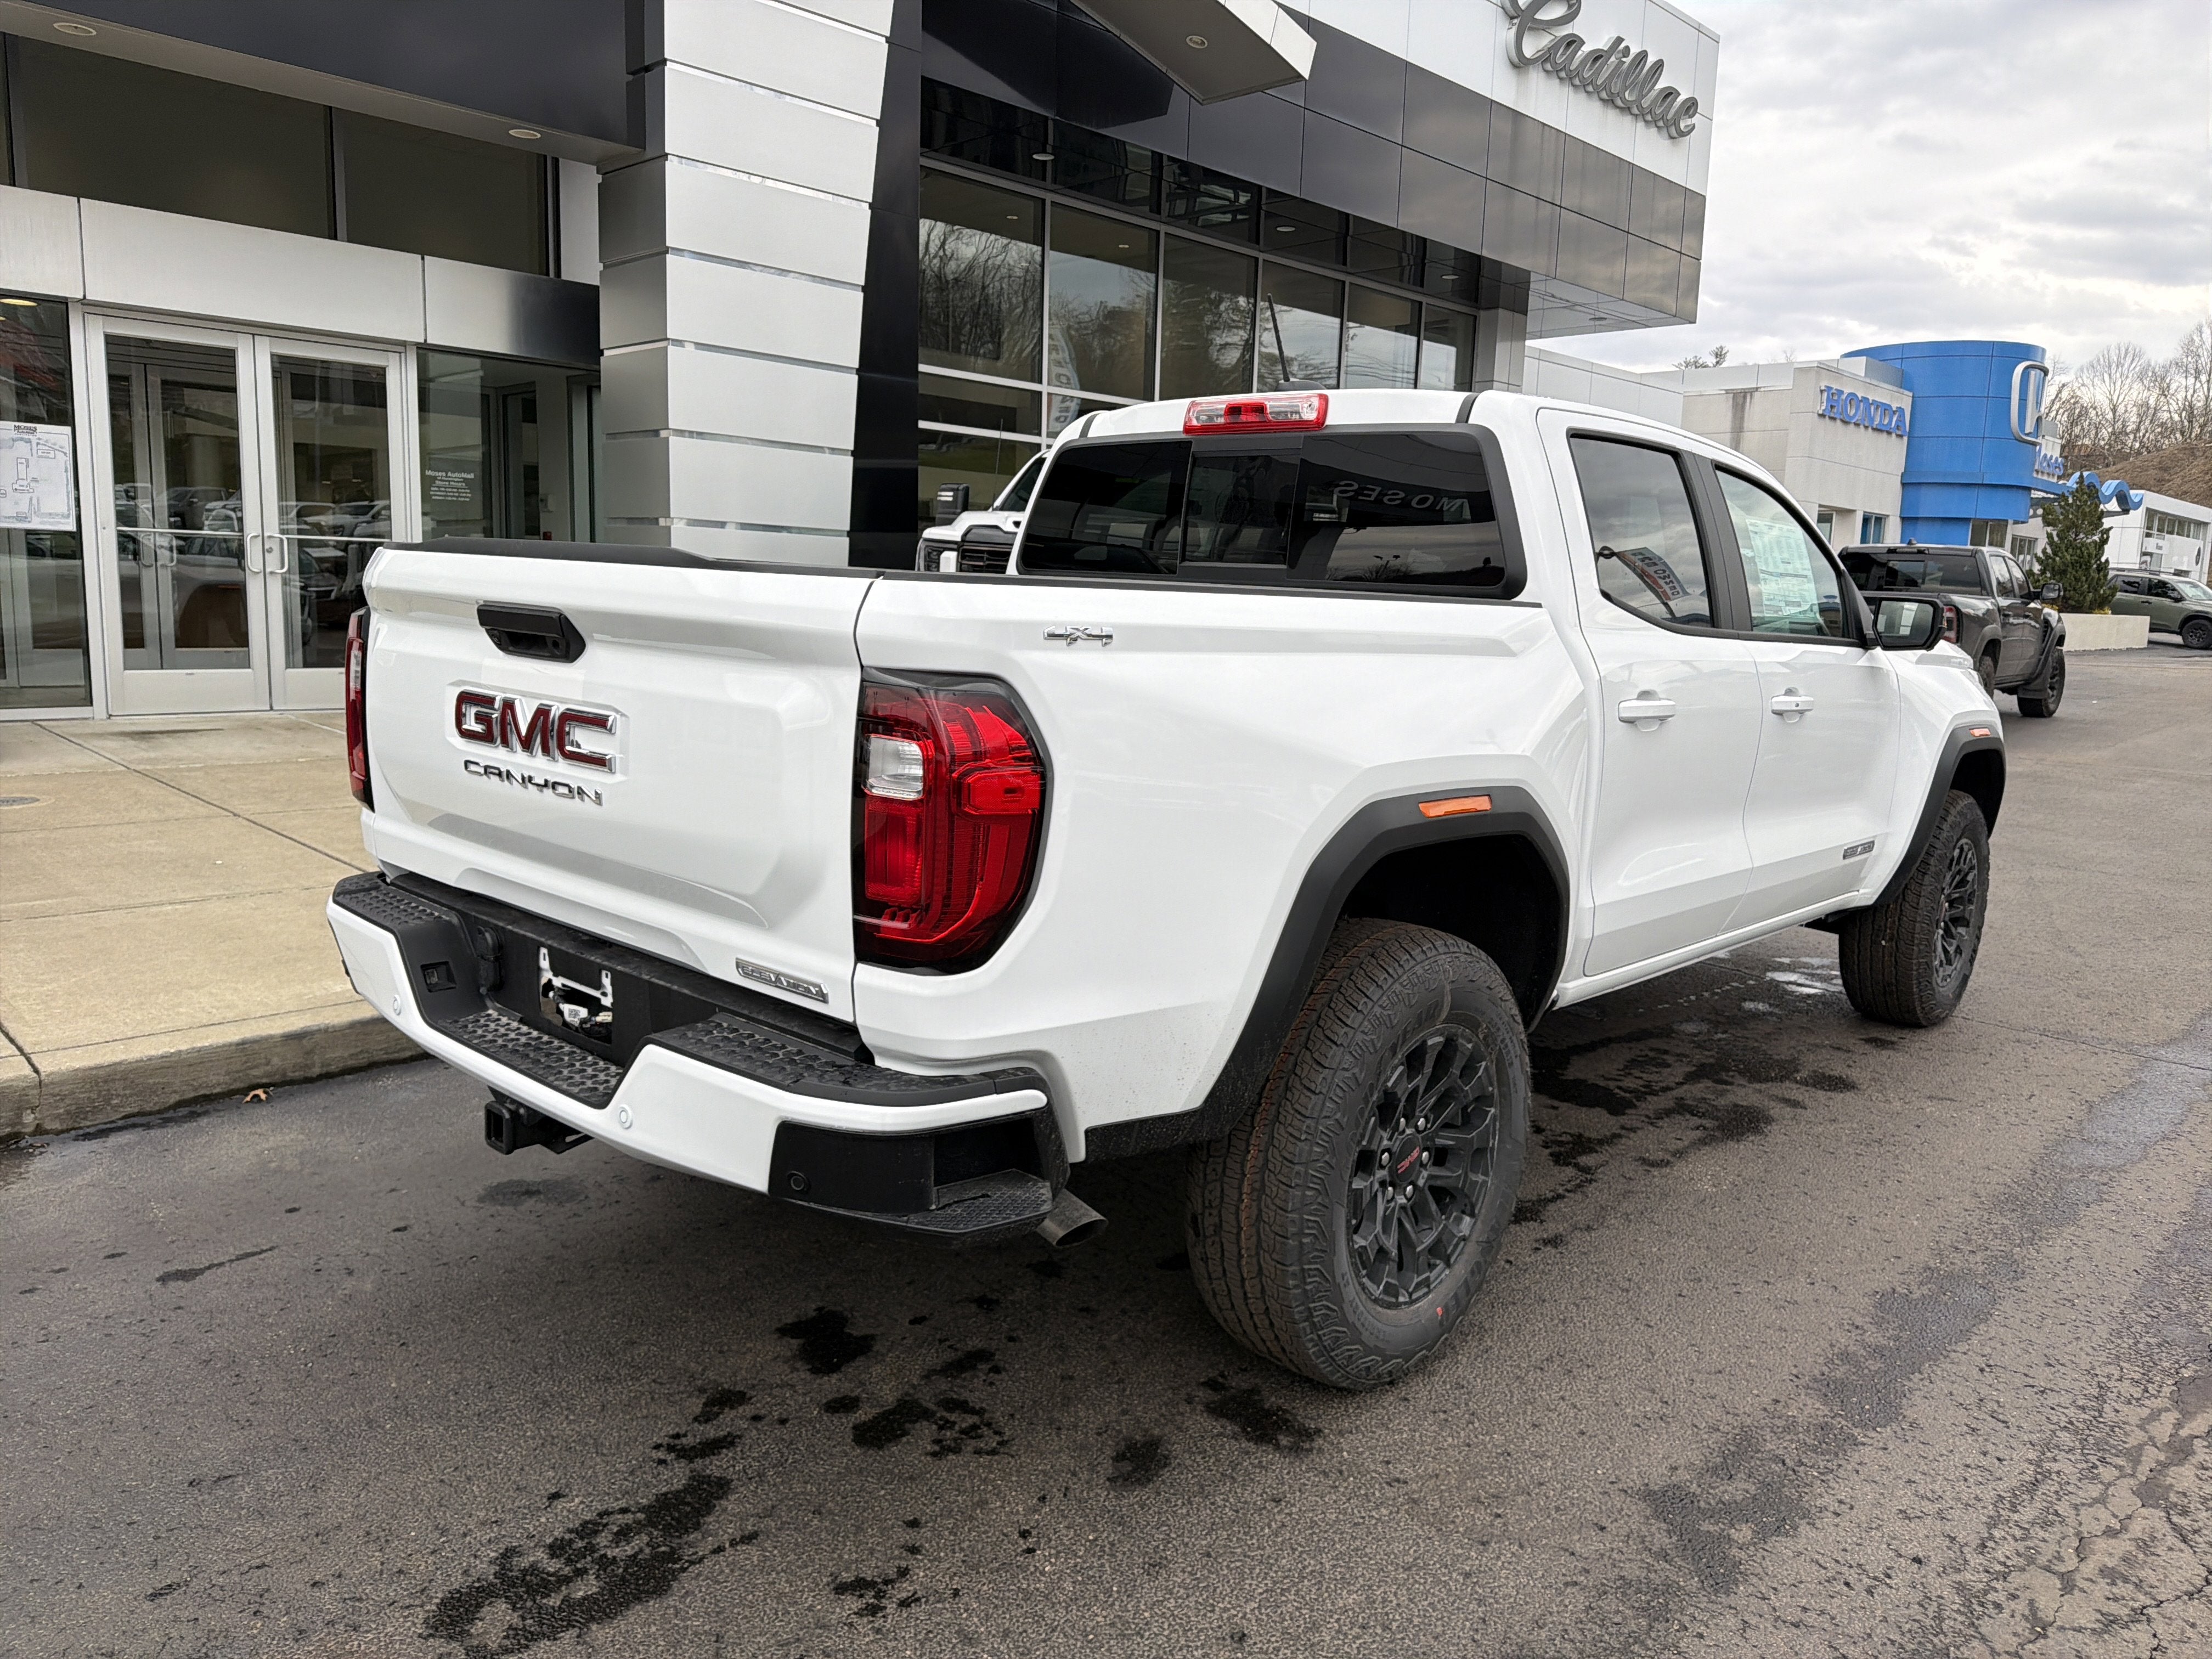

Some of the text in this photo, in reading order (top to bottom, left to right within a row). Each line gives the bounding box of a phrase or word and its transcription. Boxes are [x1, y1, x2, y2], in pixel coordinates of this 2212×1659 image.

[1500, 0, 1699, 139] Cadillac
[14, 425, 37, 433] MOSES
[1819, 385, 1908, 436] HONDA
[455, 689, 617, 774] GMC
[464, 759, 603, 806] CANYON
